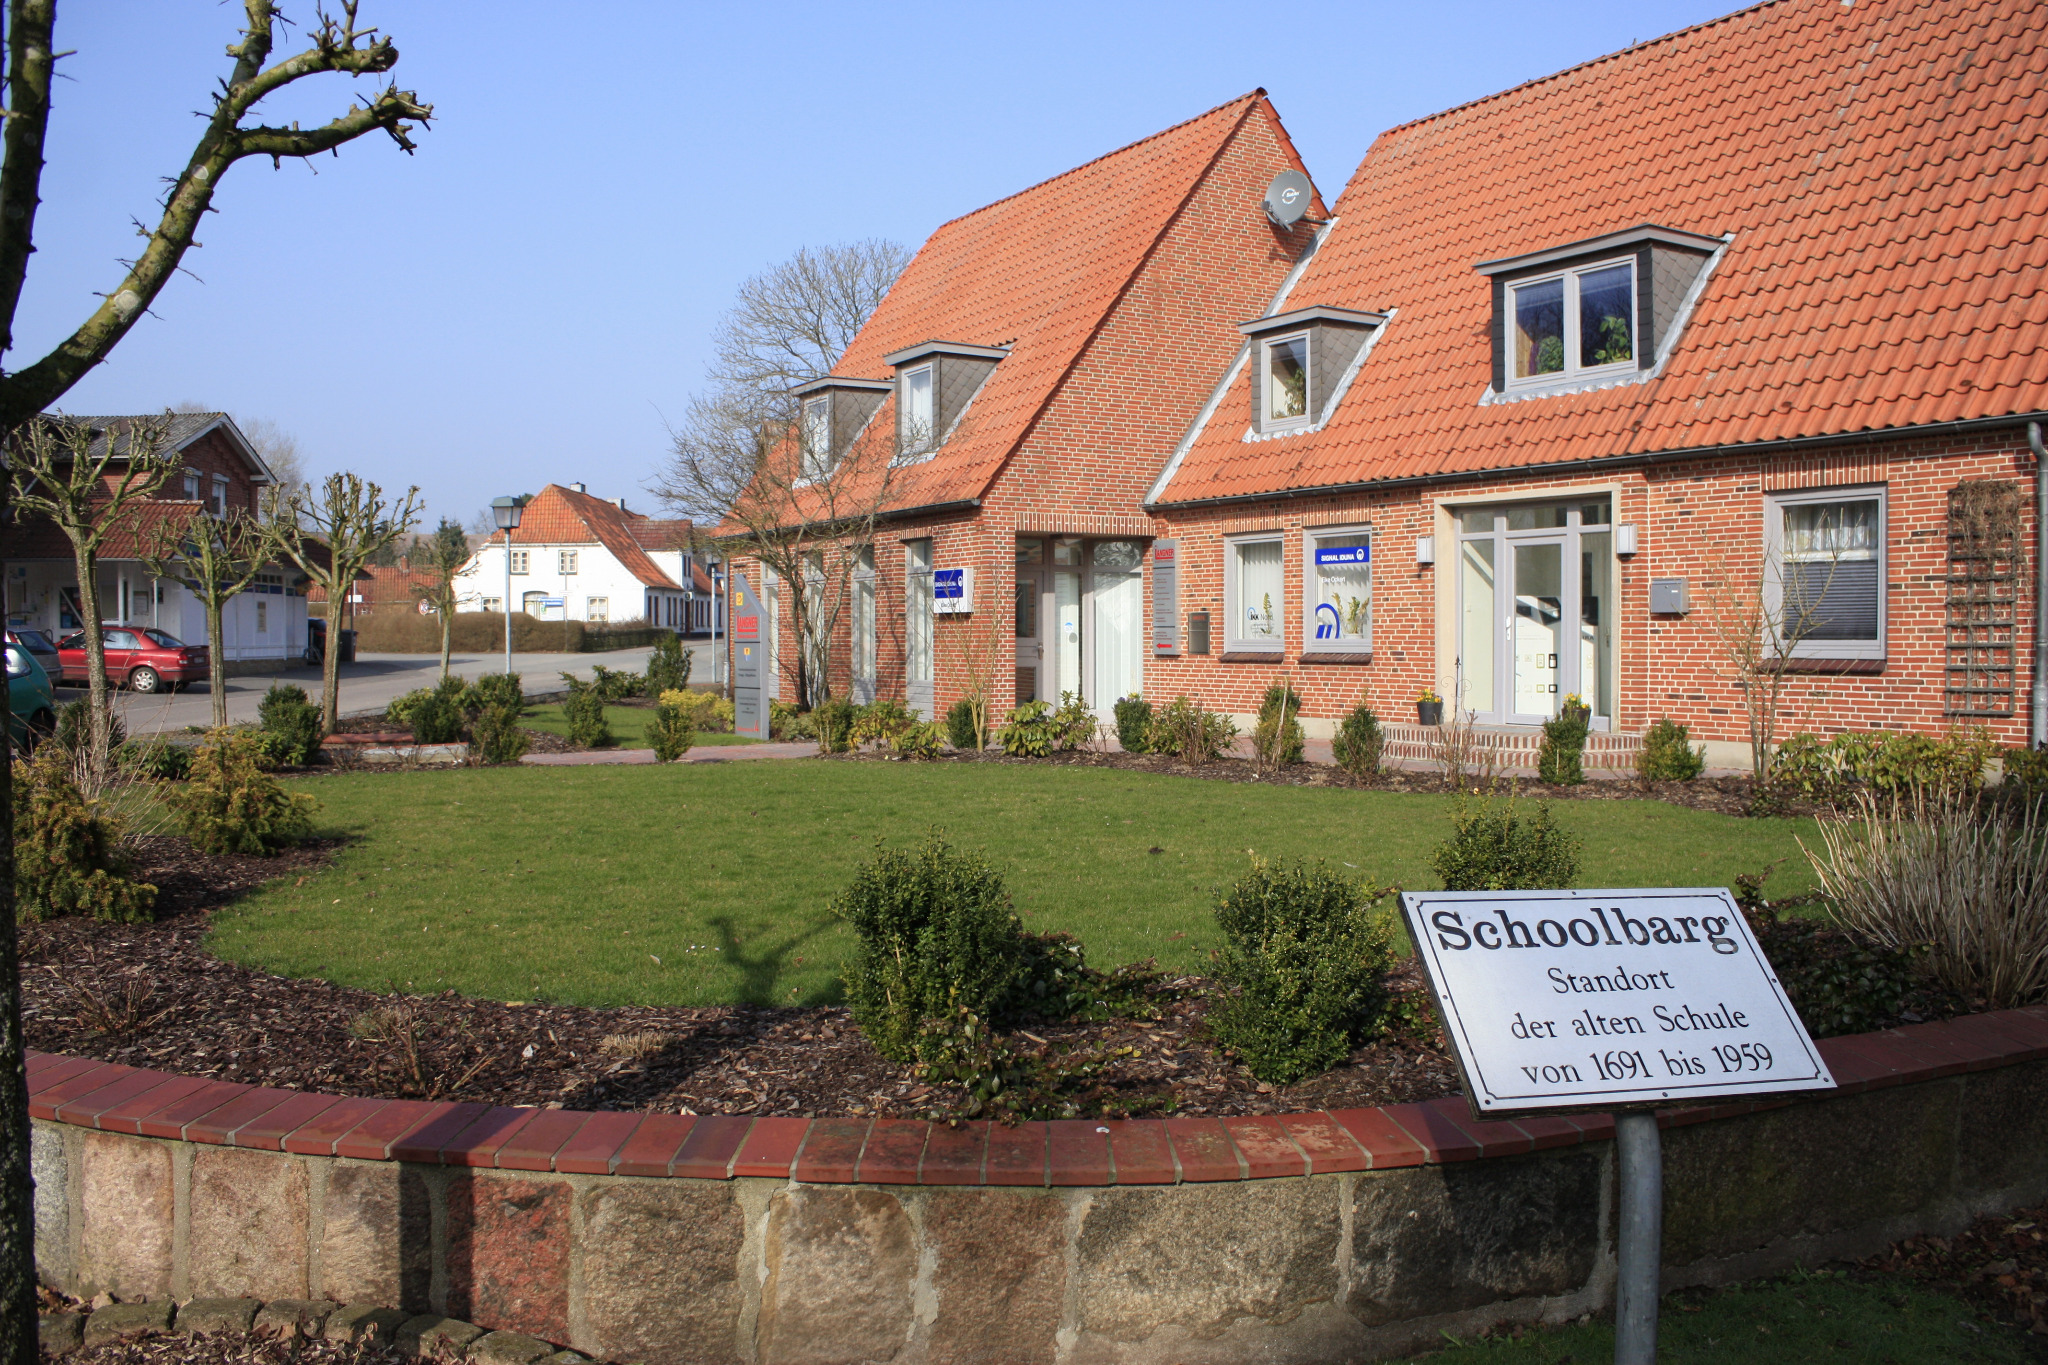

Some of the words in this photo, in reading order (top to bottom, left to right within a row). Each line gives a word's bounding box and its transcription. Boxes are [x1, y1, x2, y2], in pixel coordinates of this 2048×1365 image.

[1339, 553, 1354, 561] IDUNA
[1431, 907, 1739, 955] Schoolbarg
[1547, 965, 1675, 994] Standort
[1511, 1012, 1557, 1039] der
[1571, 1009, 1646, 1036] alten
[1652, 1003, 1750, 1033] Schule
[1520, 1065, 1583, 1085] von
[1589, 1050, 1654, 1081] 1691
[1658, 1049, 1706, 1077] bis
[1711, 1042, 1773, 1073] 1959
